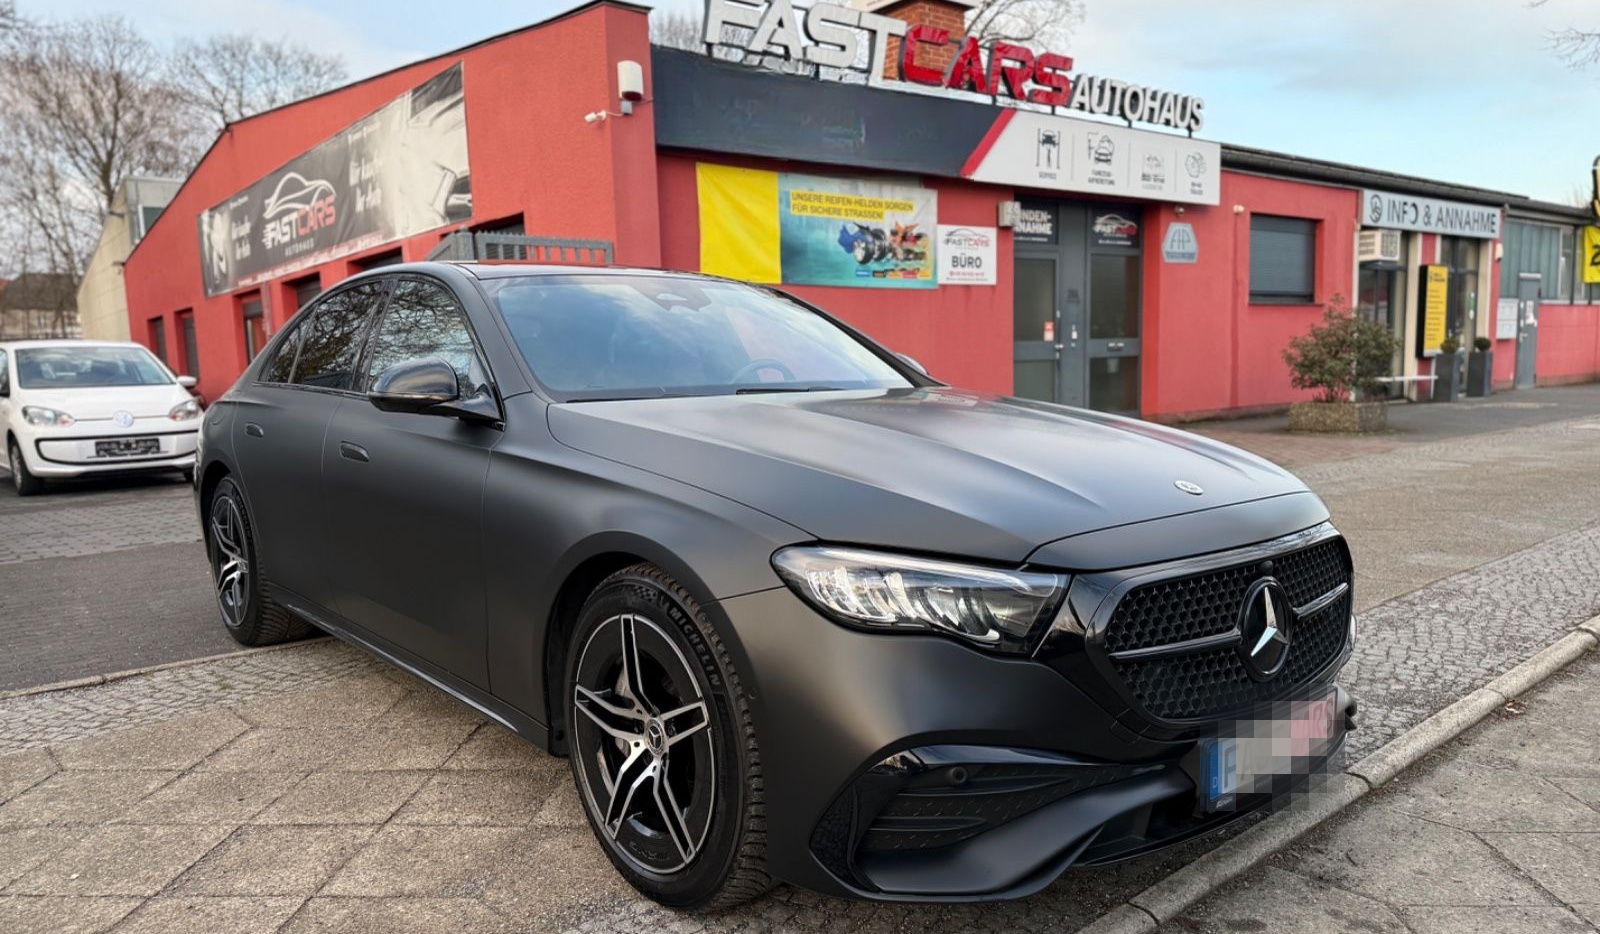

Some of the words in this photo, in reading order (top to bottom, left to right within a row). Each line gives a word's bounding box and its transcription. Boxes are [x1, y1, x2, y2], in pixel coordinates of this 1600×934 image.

[1073, 74, 1204, 131] AUTOHAUS
[792, 191, 823, 203] UNSERE
[825, 194, 883, 209] REIFEN-HELDEN
[884, 200, 914, 212] SORGEN
[792, 203, 809, 214] FÜR
[810, 205, 843, 217] SICHERE
[1423, 204, 1432, 226] &
[1435, 206, 1496, 233] ANNAHME
[952, 252, 982, 268] BÜRO
[669, 607, 720, 686] MICHELIN
